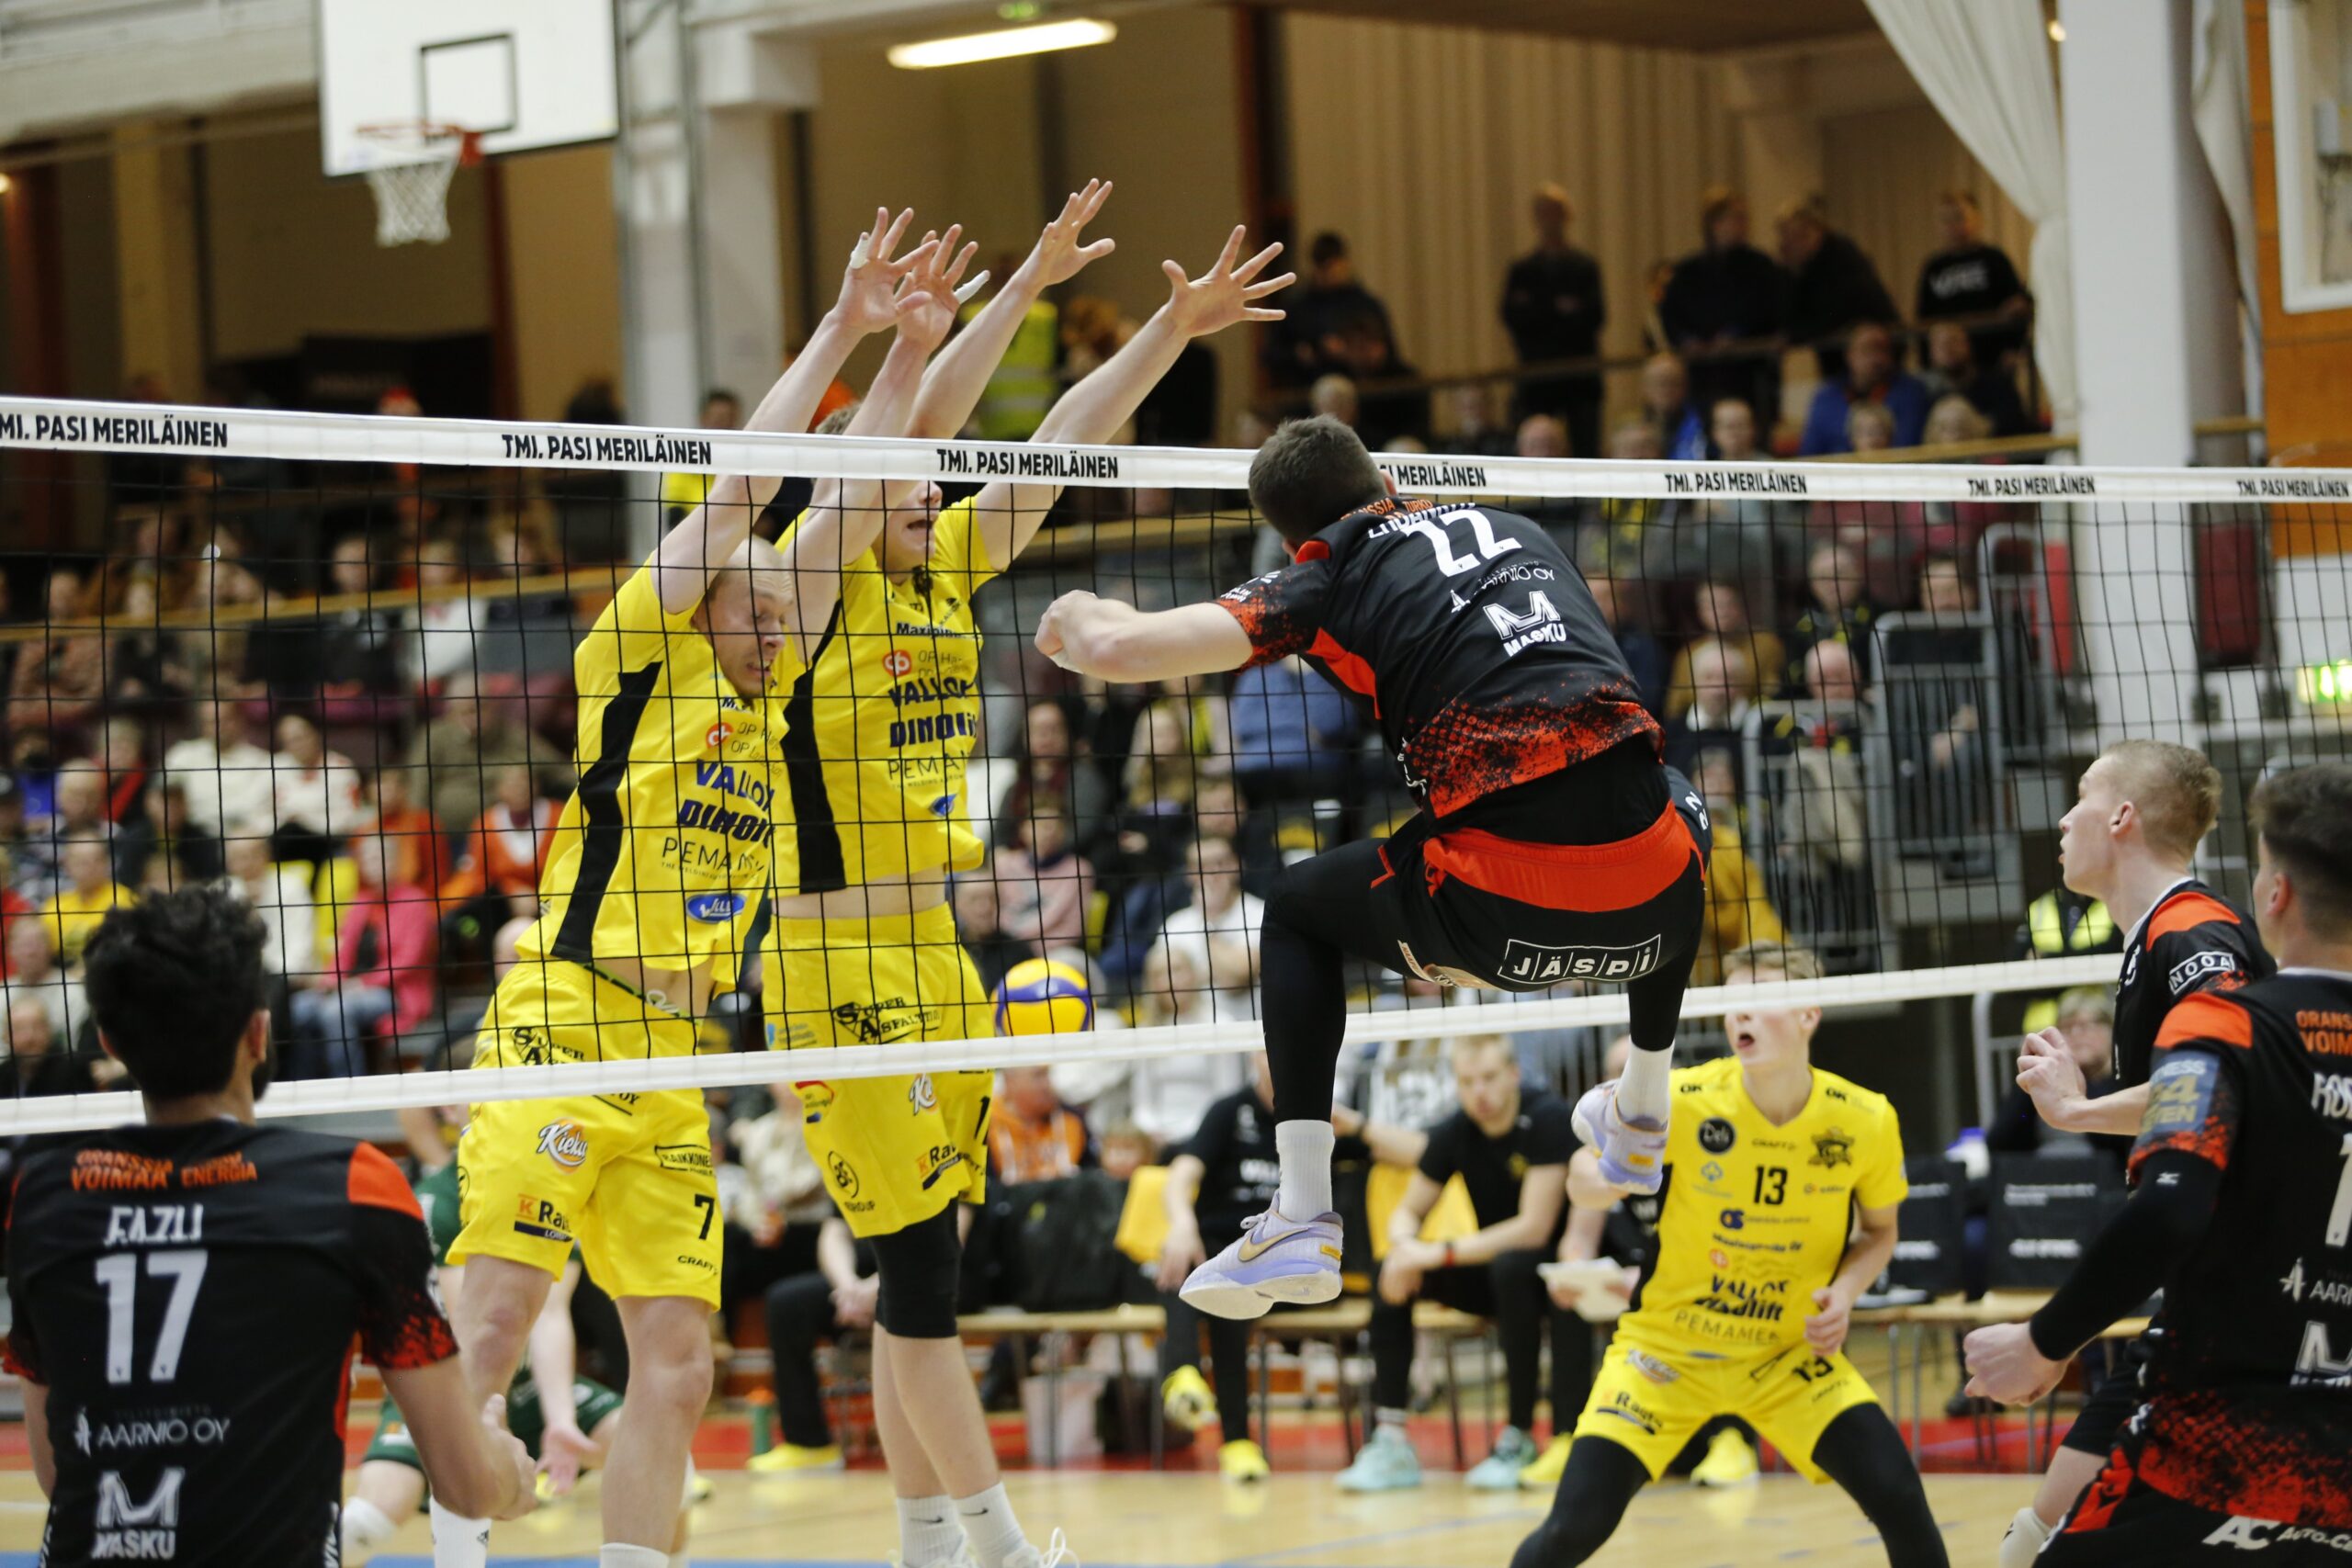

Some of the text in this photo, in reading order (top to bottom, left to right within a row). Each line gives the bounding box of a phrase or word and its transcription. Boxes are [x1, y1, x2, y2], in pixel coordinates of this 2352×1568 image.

[36, 415, 86, 442] PASI
[93, 414, 228, 447] MERILÄINEN
[502, 434, 712, 465] TMI. PASI MERILÄINEN
[936, 449, 1118, 479] TMI. PASI MERILÄINEN
[1397, 461, 1487, 487] MERILÄINEN
[1665, 469, 1807, 493] TMI. PASI MERILÄINEN
[1995, 478, 2021, 495] PASI
[2024, 472, 2095, 494] MERILÄINEN
[2261, 479, 2285, 496] PASI
[1400, 509, 1522, 577] 22
[1533, 568, 1555, 581] OY
[1502, 623, 1566, 657] MASKU
[888, 750, 966, 780] PEMA
[2170, 955, 2232, 987] NOOA
[1753, 1165, 1788, 1205] 13
[694, 1193, 715, 1240] 7
[96, 1249, 209, 1384] 17
[98, 1418, 231, 1448] AARNIO OY
